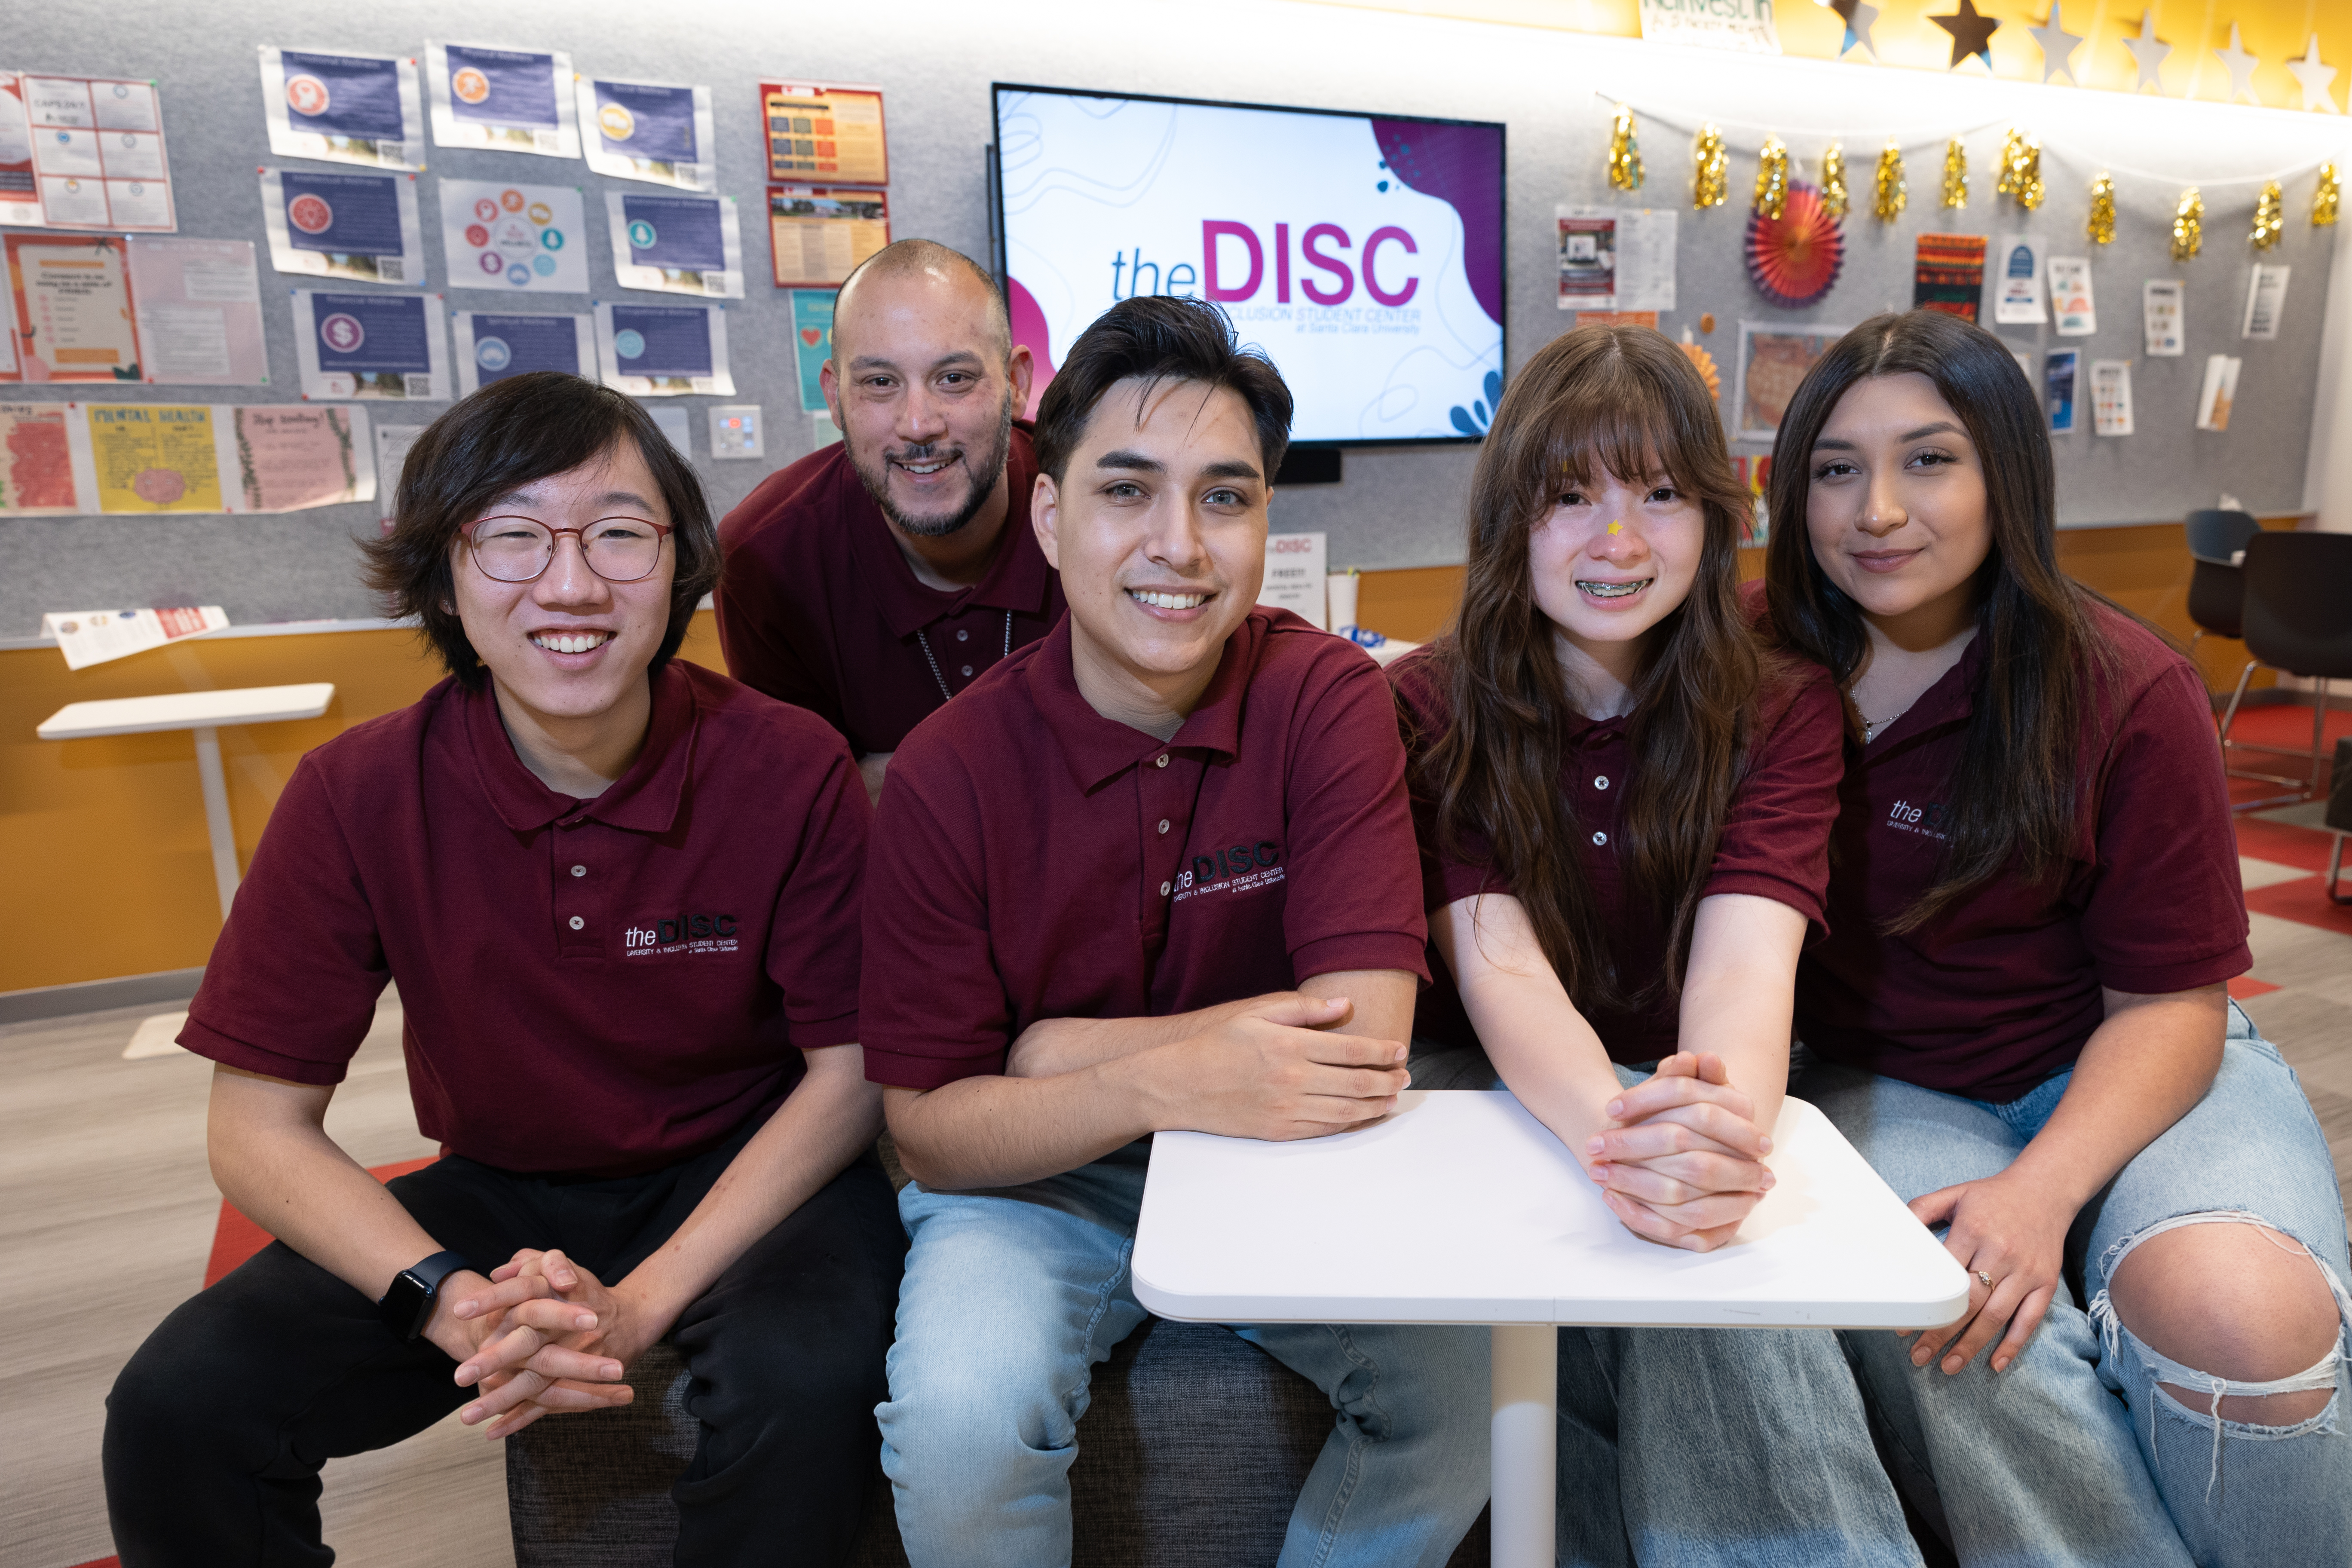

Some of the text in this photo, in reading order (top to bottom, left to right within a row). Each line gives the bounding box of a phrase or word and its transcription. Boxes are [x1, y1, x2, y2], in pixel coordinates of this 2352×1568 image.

[1294, 306, 1361, 324] STUDENT
[1364, 307, 1421, 324] CENTER
[1309, 322, 1338, 334] Santa
[1342, 322, 1369, 334] Clara
[1372, 323, 1420, 336] University
[1199, 881, 1230, 894] INCLUSION
[1231, 873, 1258, 886] STUDENT
[1260, 867, 1283, 879] CENTER
[627, 948, 654, 957] DIVERSITY
